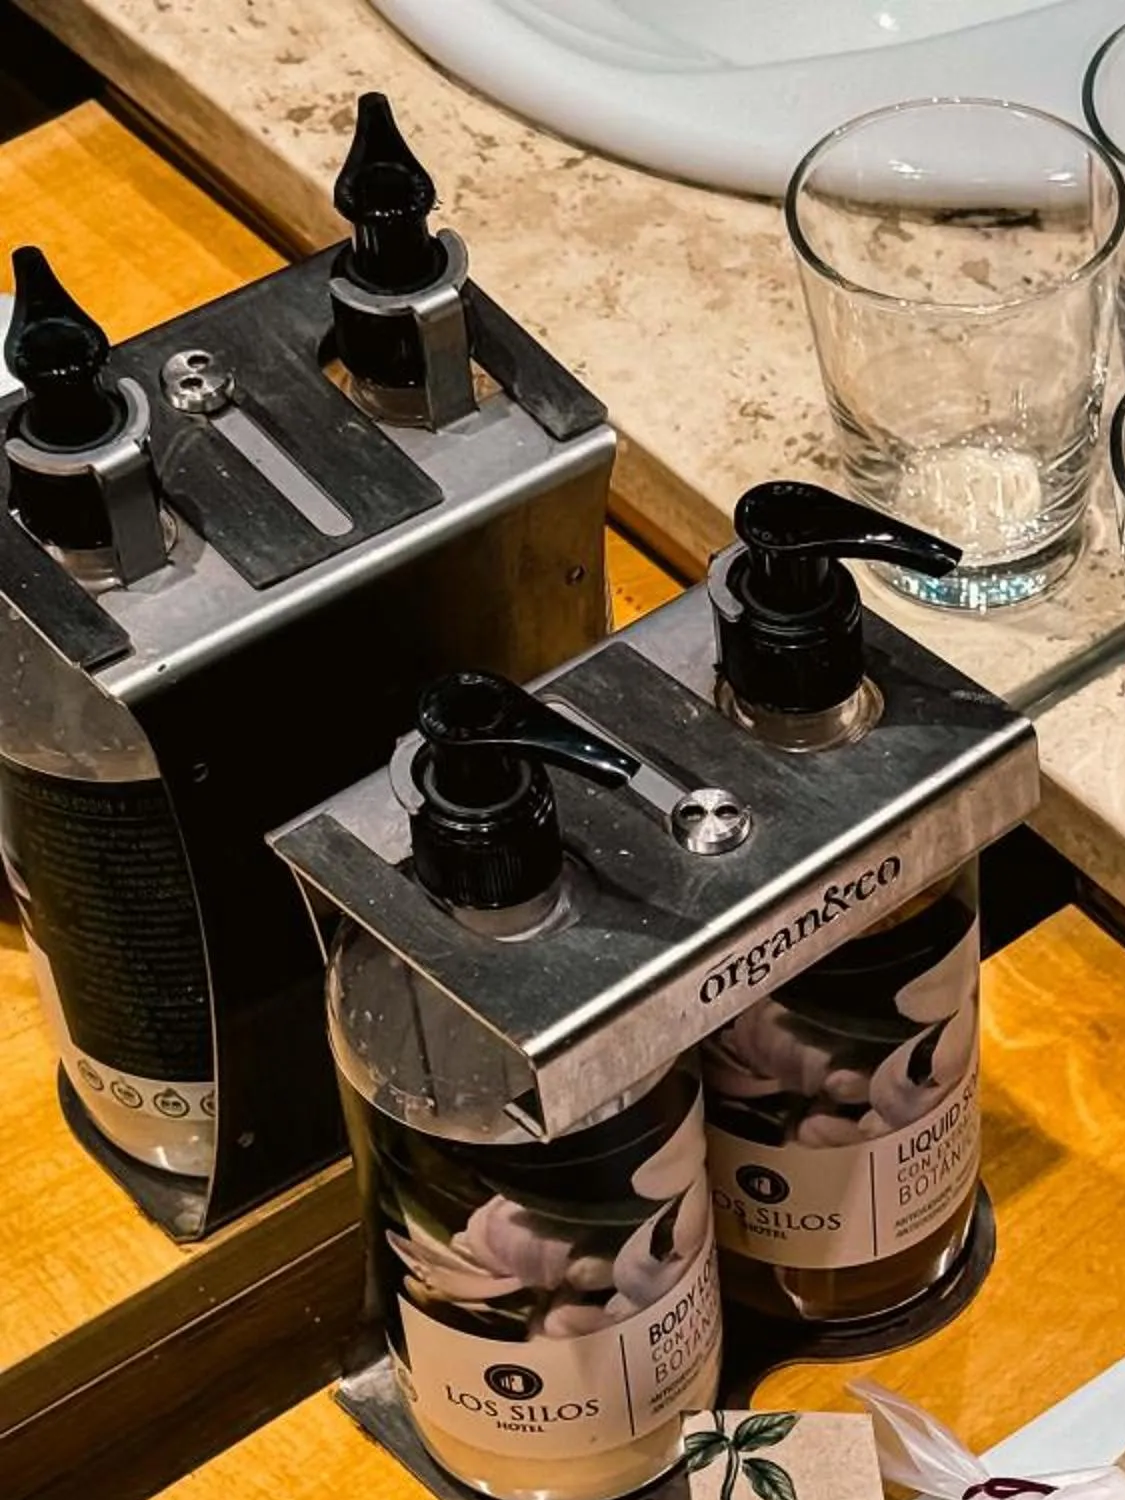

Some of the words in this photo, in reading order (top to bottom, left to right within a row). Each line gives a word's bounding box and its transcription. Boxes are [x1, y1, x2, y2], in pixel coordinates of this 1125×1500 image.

[897, 1103, 962, 1165] LIQUID
[897, 1155, 931, 1184] CON
[711, 1189, 746, 1219] OS
[756, 1210, 842, 1232] SILOS
[748, 1223, 788, 1241] HOTEL
[649, 1286, 696, 1346] BODY
[651, 1330, 686, 1362] CON
[446, 1384, 499, 1417] LOS
[510, 1399, 600, 1423] SILOS
[496, 1420, 545, 1434] HOTEL
